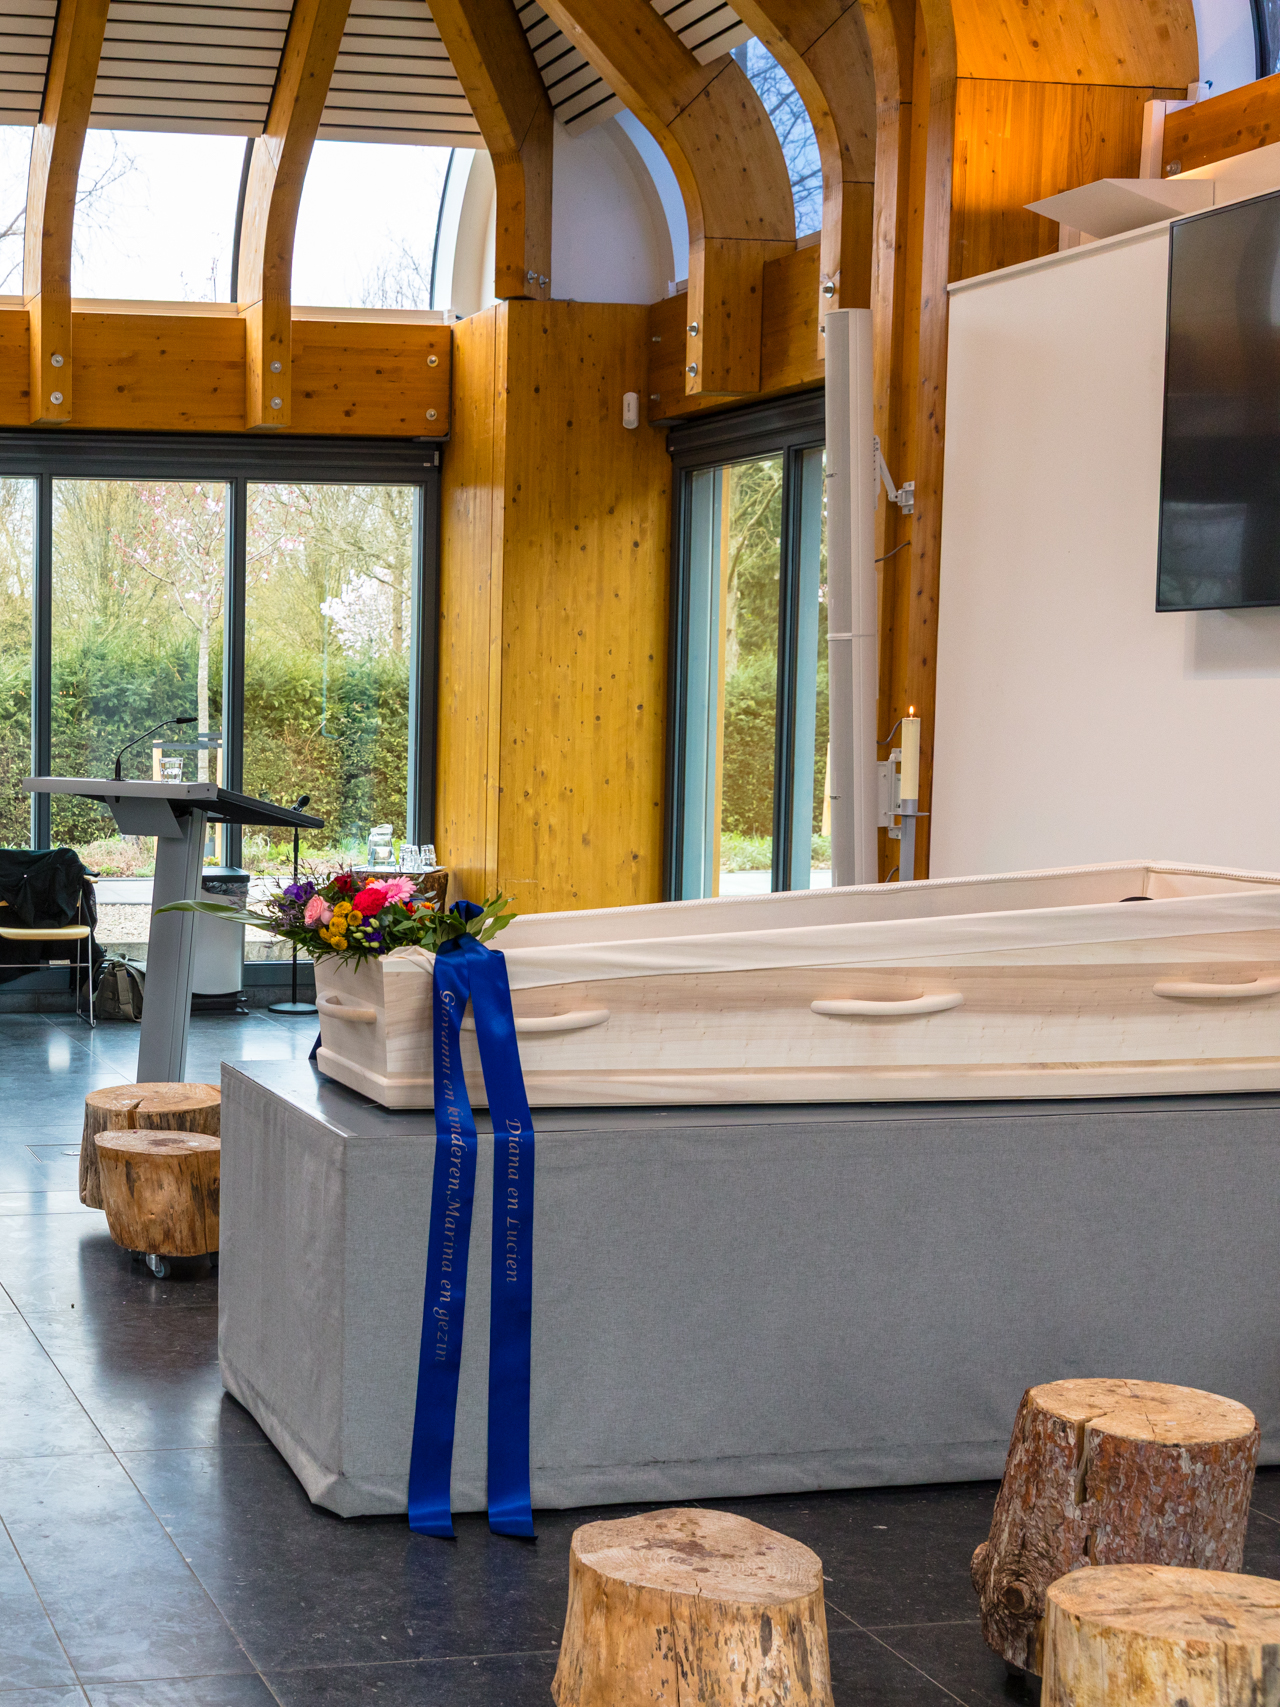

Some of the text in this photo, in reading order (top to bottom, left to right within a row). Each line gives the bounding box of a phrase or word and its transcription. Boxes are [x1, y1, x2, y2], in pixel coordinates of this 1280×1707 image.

[440, 990, 456, 1076] Giovanni
[443, 1079, 455, 1100] en
[506, 1118, 523, 1283] Diana en Lucien
[440, 1279, 452, 1302] en
[433, 1306, 450, 1362] gezin
